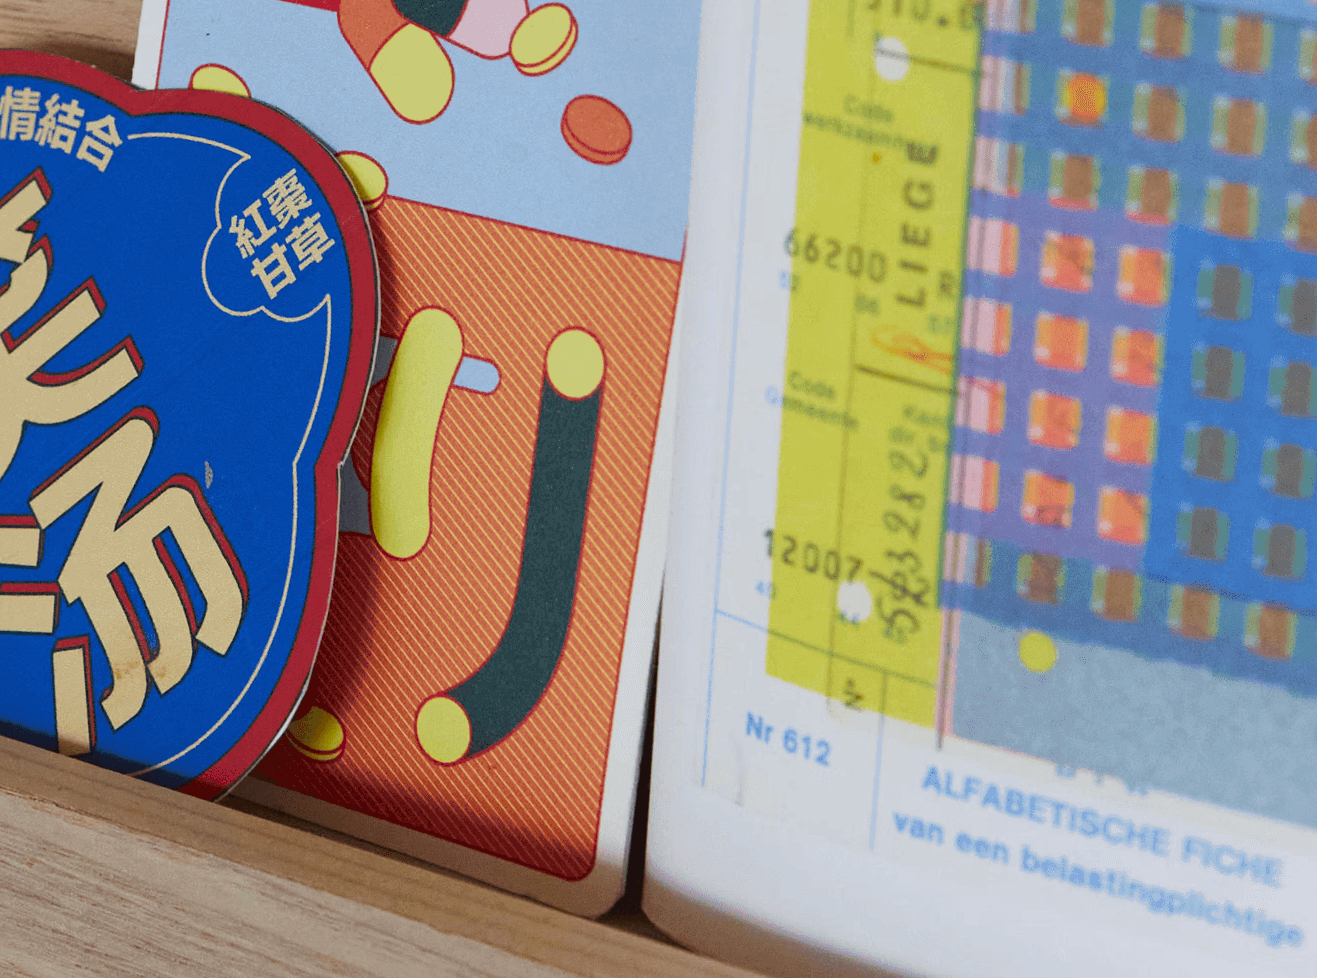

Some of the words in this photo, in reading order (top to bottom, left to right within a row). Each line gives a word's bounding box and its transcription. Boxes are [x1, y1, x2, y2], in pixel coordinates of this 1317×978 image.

[229, 168, 313, 260] 紅棗
[250, 211, 336, 301] 甘草
[894, 139, 940, 309] LIEGE
[745, 710, 775, 745] Nr
[781, 726, 832, 767] 612
[891, 810, 945, 845] van
[954, 830, 1010, 865] een
[1019, 844, 1305, 949] belastingplichtige
[921, 764, 1171, 858] ALFABETISCHE
[1181, 834, 1283, 890] FICHE
